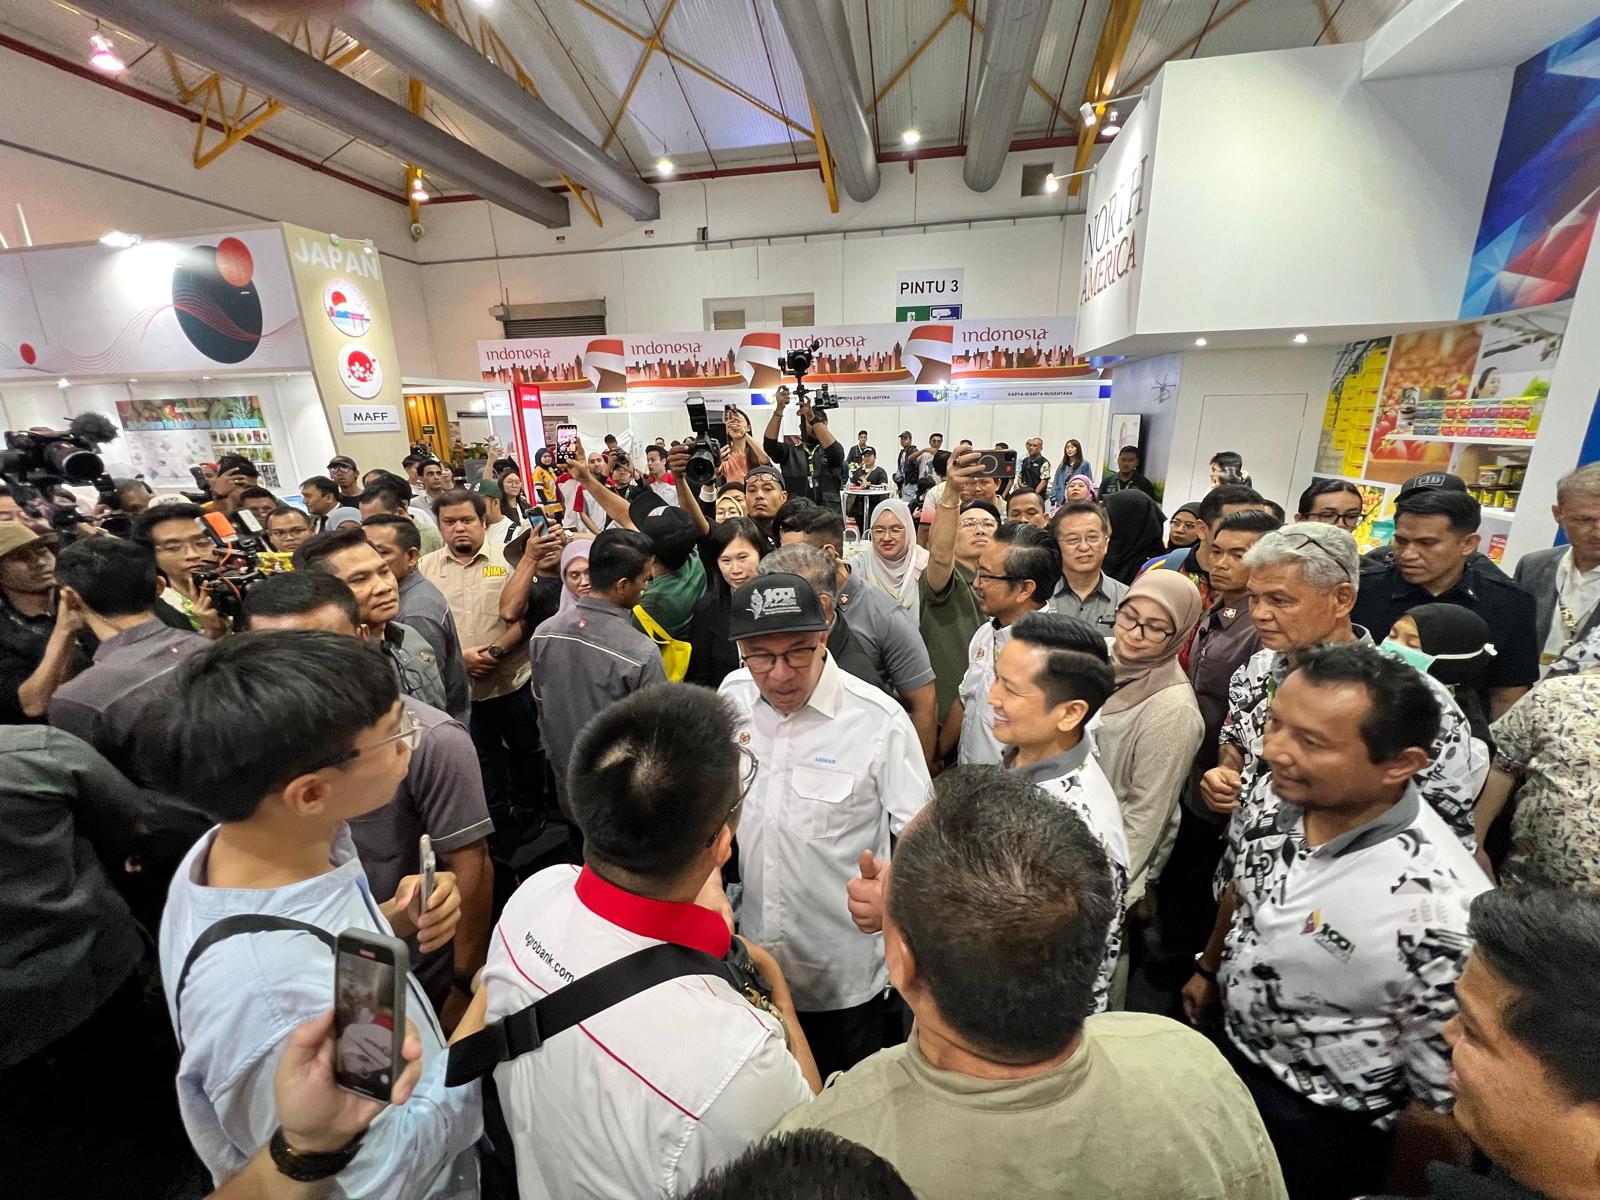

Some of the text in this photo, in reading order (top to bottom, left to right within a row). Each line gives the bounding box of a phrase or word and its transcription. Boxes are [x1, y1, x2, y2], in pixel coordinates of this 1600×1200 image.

[294, 238, 380, 281] JAPAN
[1080, 230, 1137, 306] AMERICA
[900, 279, 959, 295] PINTU 3
[961, 326, 1049, 343] indonesia
[486, 347, 551, 361] indonesia
[631, 340, 703, 355] indonesia
[353, 412, 388, 422] MAFF
[483, 564, 507, 578] NIMS
[525, 931, 575, 983] agrobank.com
